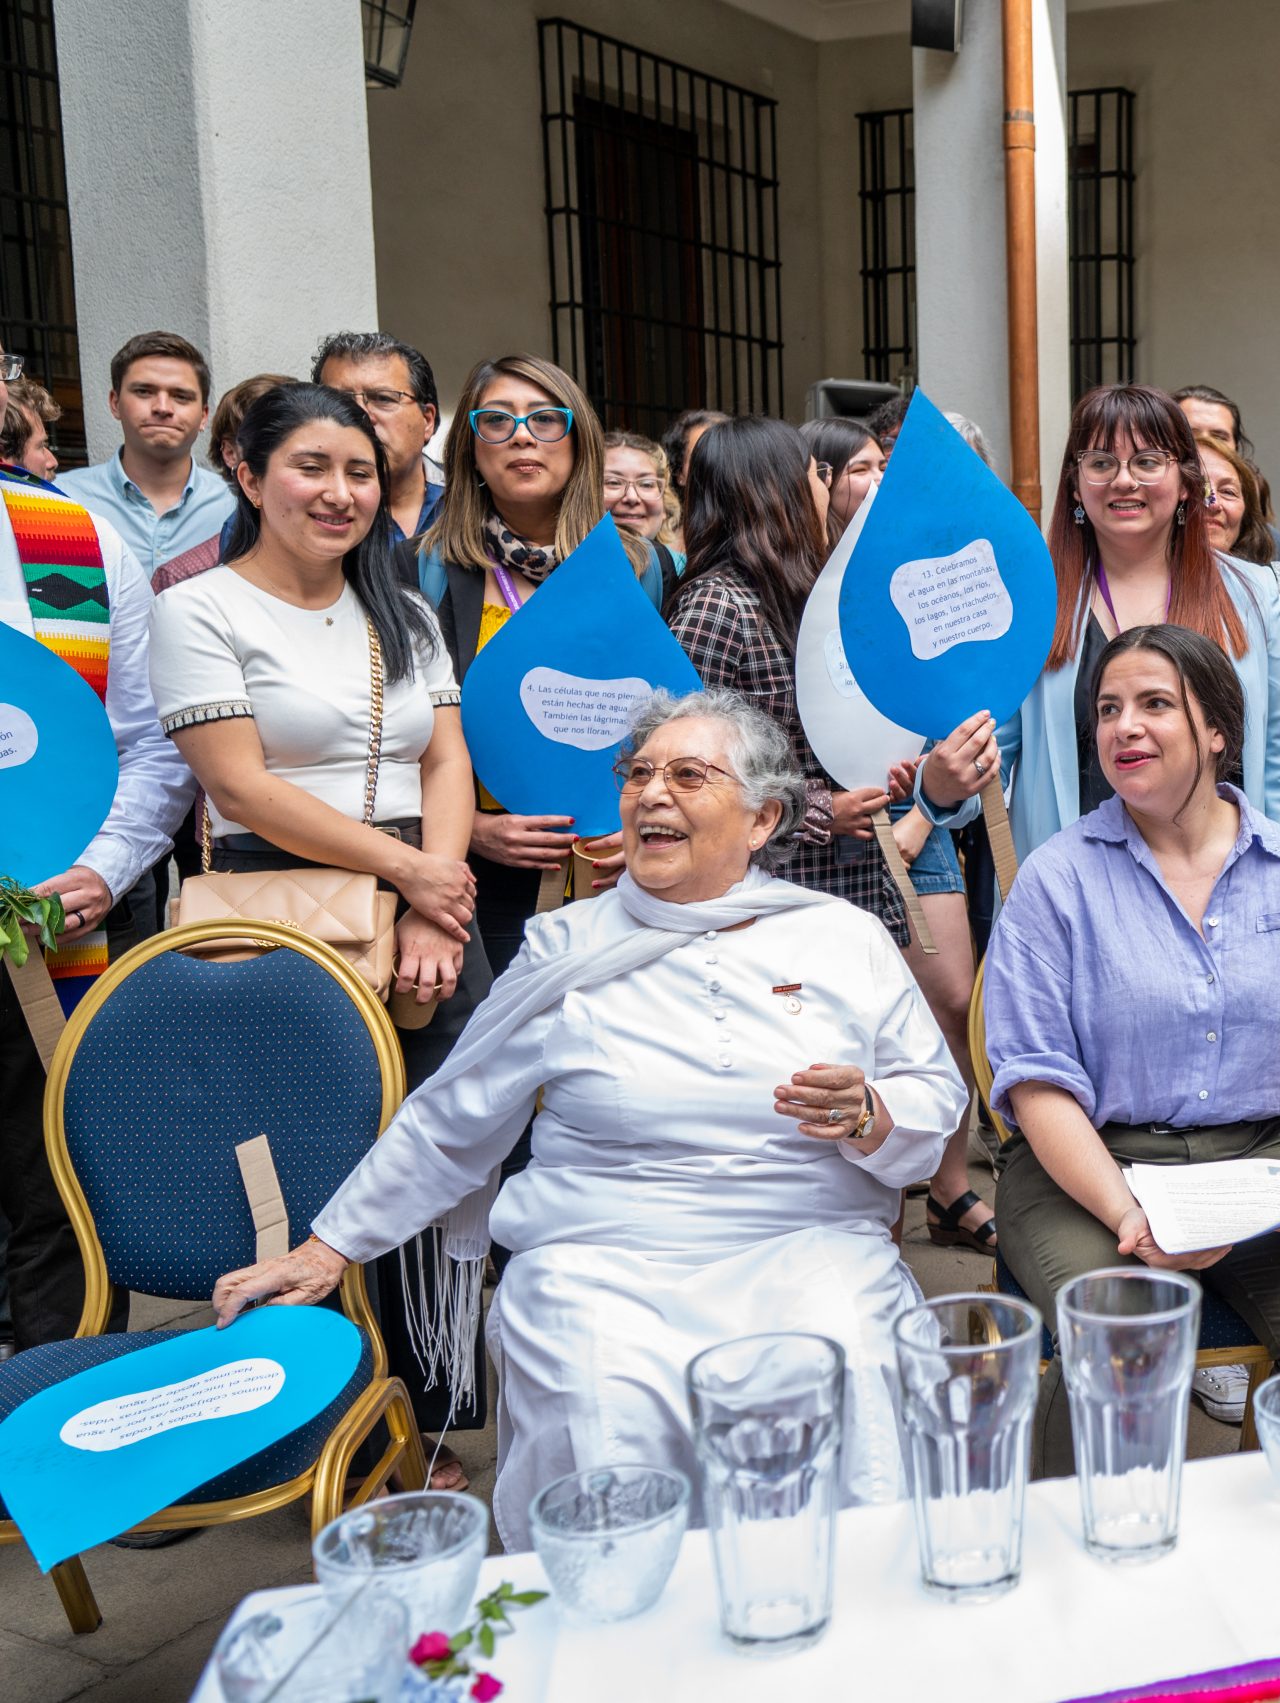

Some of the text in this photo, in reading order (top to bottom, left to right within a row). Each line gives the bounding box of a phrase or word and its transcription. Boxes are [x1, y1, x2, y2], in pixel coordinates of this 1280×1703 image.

[922, 556, 978, 579] 13. Celebramos
[908, 565, 995, 599] el agua en las montañas,
[917, 581, 991, 610] los océanos, los ríos,
[914, 592, 1000, 625] los lagos, los riachuelos,
[933, 609, 988, 633] en nuestra casa
[932, 622, 993, 649] y nuestro cuerpo.
[538, 685, 552, 694] Las
[554, 686, 583, 696] células
[584, 690, 600, 698] que
[541, 698, 564, 708] están
[566, 700, 595, 710] hechas
[543, 711, 578, 721] También
[580, 714, 592, 722] las
[553, 726, 569, 734] que
[587, 726, 613, 736] lloran.
[243, 1372, 279, 1382] desde
[116, 1366, 253, 1410] Nacimos desde el agua.
[192, 1384, 224, 1397] inicio
[231, 1385, 272, 1396] fuimos
[173, 1395, 189, 1403] de
[119, 1401, 170, 1419] nuestras
[150, 1394, 228, 1420] cobijados/as
[80, 1418, 114, 1426] vidas.
[126, 1416, 146, 1427] por
[168, 1410, 203, 1424] Todos
[76, 1429, 106, 1438] agua
[120, 1425, 152, 1439] todas
